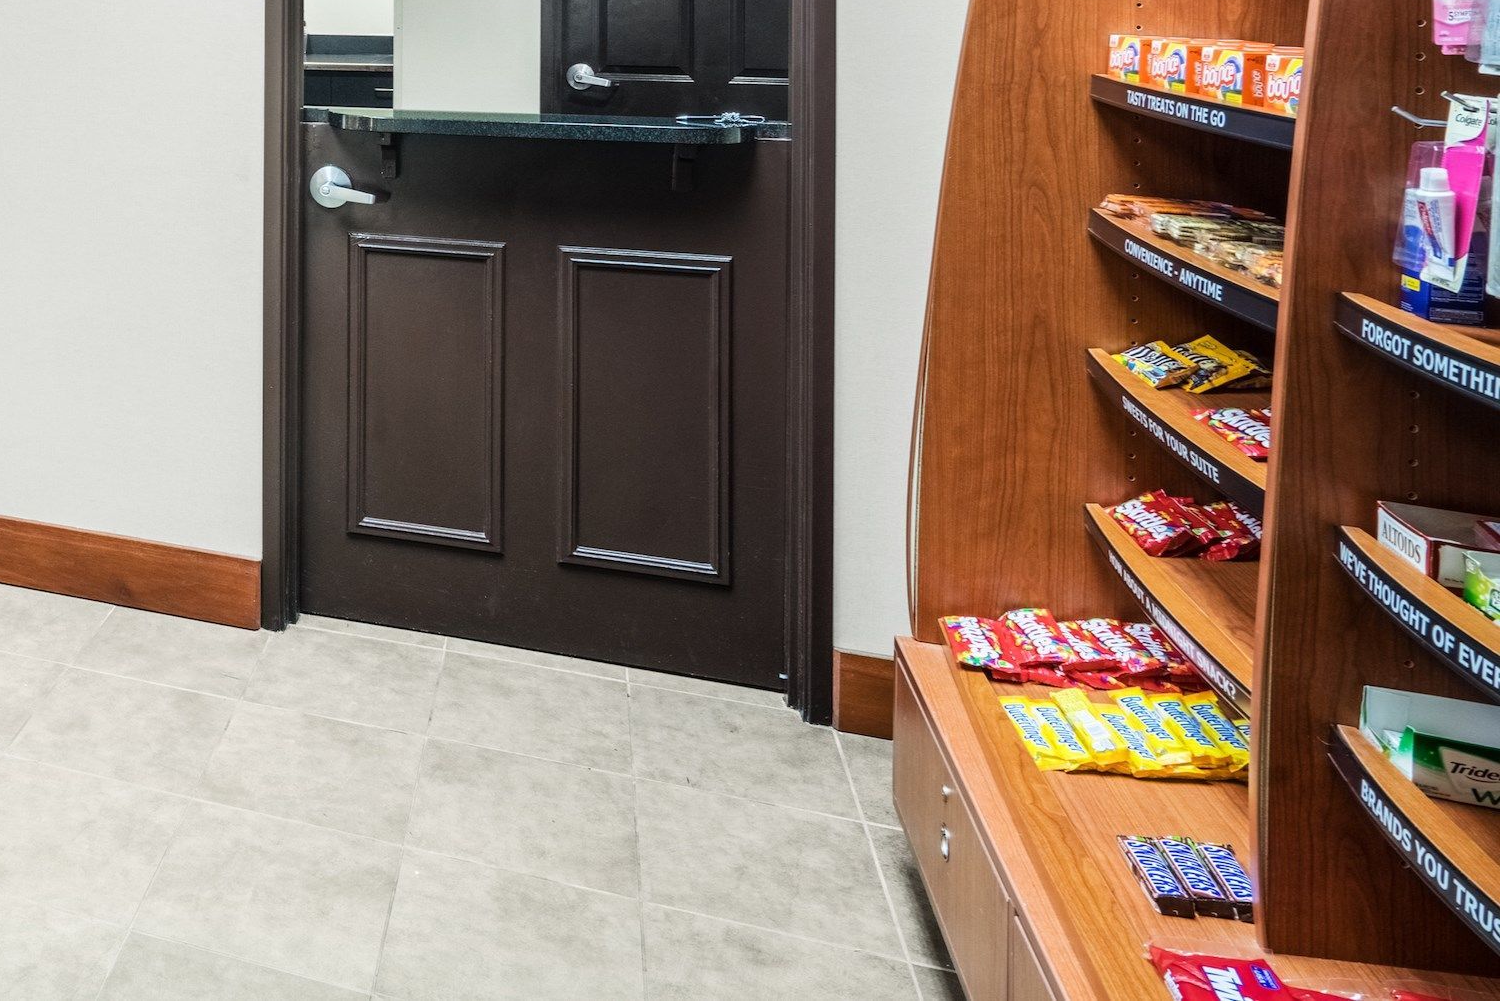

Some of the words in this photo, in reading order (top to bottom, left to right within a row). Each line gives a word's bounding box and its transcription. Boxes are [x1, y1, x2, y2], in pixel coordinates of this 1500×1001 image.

[1448, 11, 1454, 21] 5
[1110, 47, 1134, 69] bounce
[1152, 54, 1179, 77] bounce
[1202, 62, 1235, 86] bounce
[1252, 69, 1264, 98] bounce
[1127, 89, 1146, 106] TASTY
[1147, 94, 1174, 116] TREATS
[1176, 102, 1188, 118] ON
[1190, 104, 1208, 123] THE
[1209, 109, 1226, 127] GO
[1455, 113, 1483, 128] Colgate
[1125, 238, 1173, 278] CONVENIENCE
[1179, 270, 1223, 302] ANYTIME
[1361, 318, 1412, 360] FORGOT
[1122, 395, 1148, 429] SWEETS
[1148, 417, 1165, 438] FOR
[1164, 429, 1189, 462] YOUR
[1190, 446, 1220, 484] SUITE
[1116, 498, 1174, 542] Skittles
[1381, 520, 1422, 564] ALTOIDS
[1339, 541, 1366, 585] WE'VE
[1367, 569, 1430, 636] THOUGHT
[1431, 624, 1456, 654] OF
[1081, 618, 1135, 663] Skittles
[1122, 568, 1145, 603] ABOUT
[1151, 601, 1196, 666] MIDNIGHT
[1196, 652, 1237, 700] SNACK?
[1004, 703, 1051, 752] Butterfinger
[1035, 706, 1088, 756] Butterfinger
[1102, 712, 1158, 762] Butterfinger
[1120, 695, 1173, 743] Butterfinger
[1157, 699, 1218, 749] Butterfinger
[1191, 703, 1249, 752] Butterfinger
[1360, 778, 1412, 852] BRANDS
[1415, 838, 1450, 891] YOU
[1127, 839, 1183, 896] SNICKERS
[1160, 839, 1224, 897] SNICKERS
